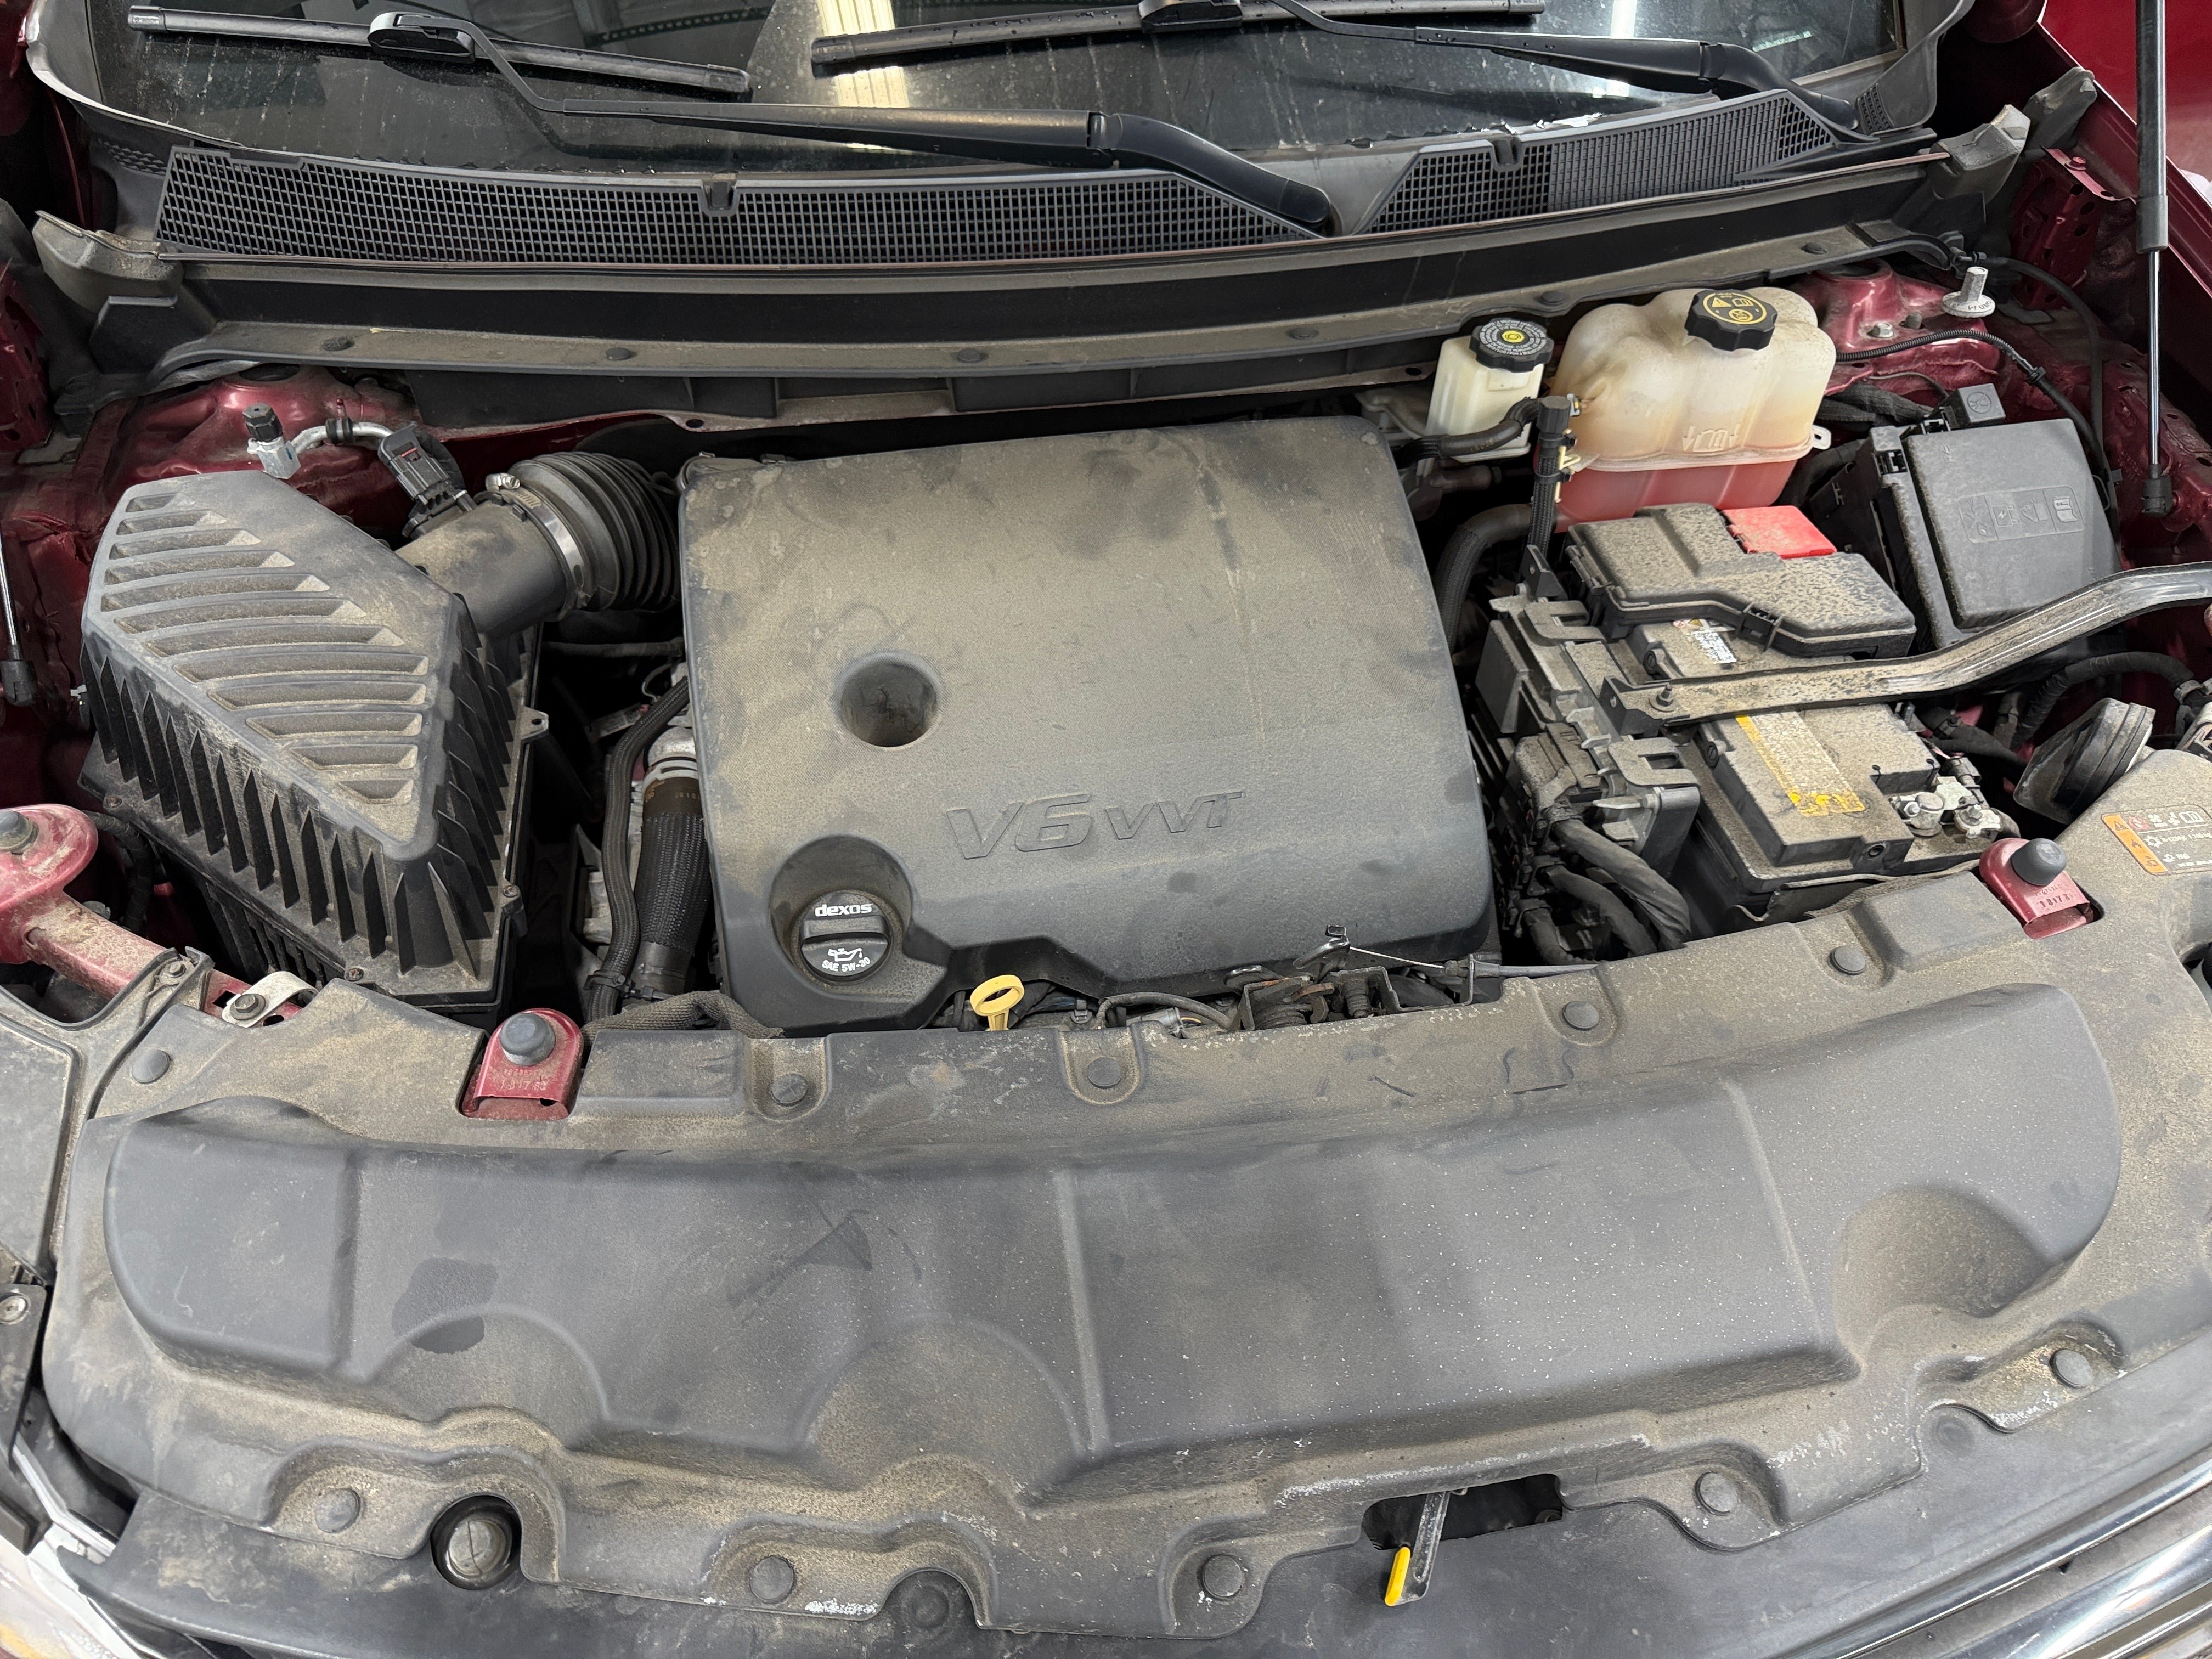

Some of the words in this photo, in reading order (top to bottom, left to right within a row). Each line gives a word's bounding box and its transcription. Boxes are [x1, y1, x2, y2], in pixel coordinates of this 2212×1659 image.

[946, 793, 1094, 860] V6
[1105, 791, 1243, 840] VVT
[815, 903, 874, 917] dexos
[822, 960, 839, 972] SAE
[842, 957, 871, 972] 5W-30
